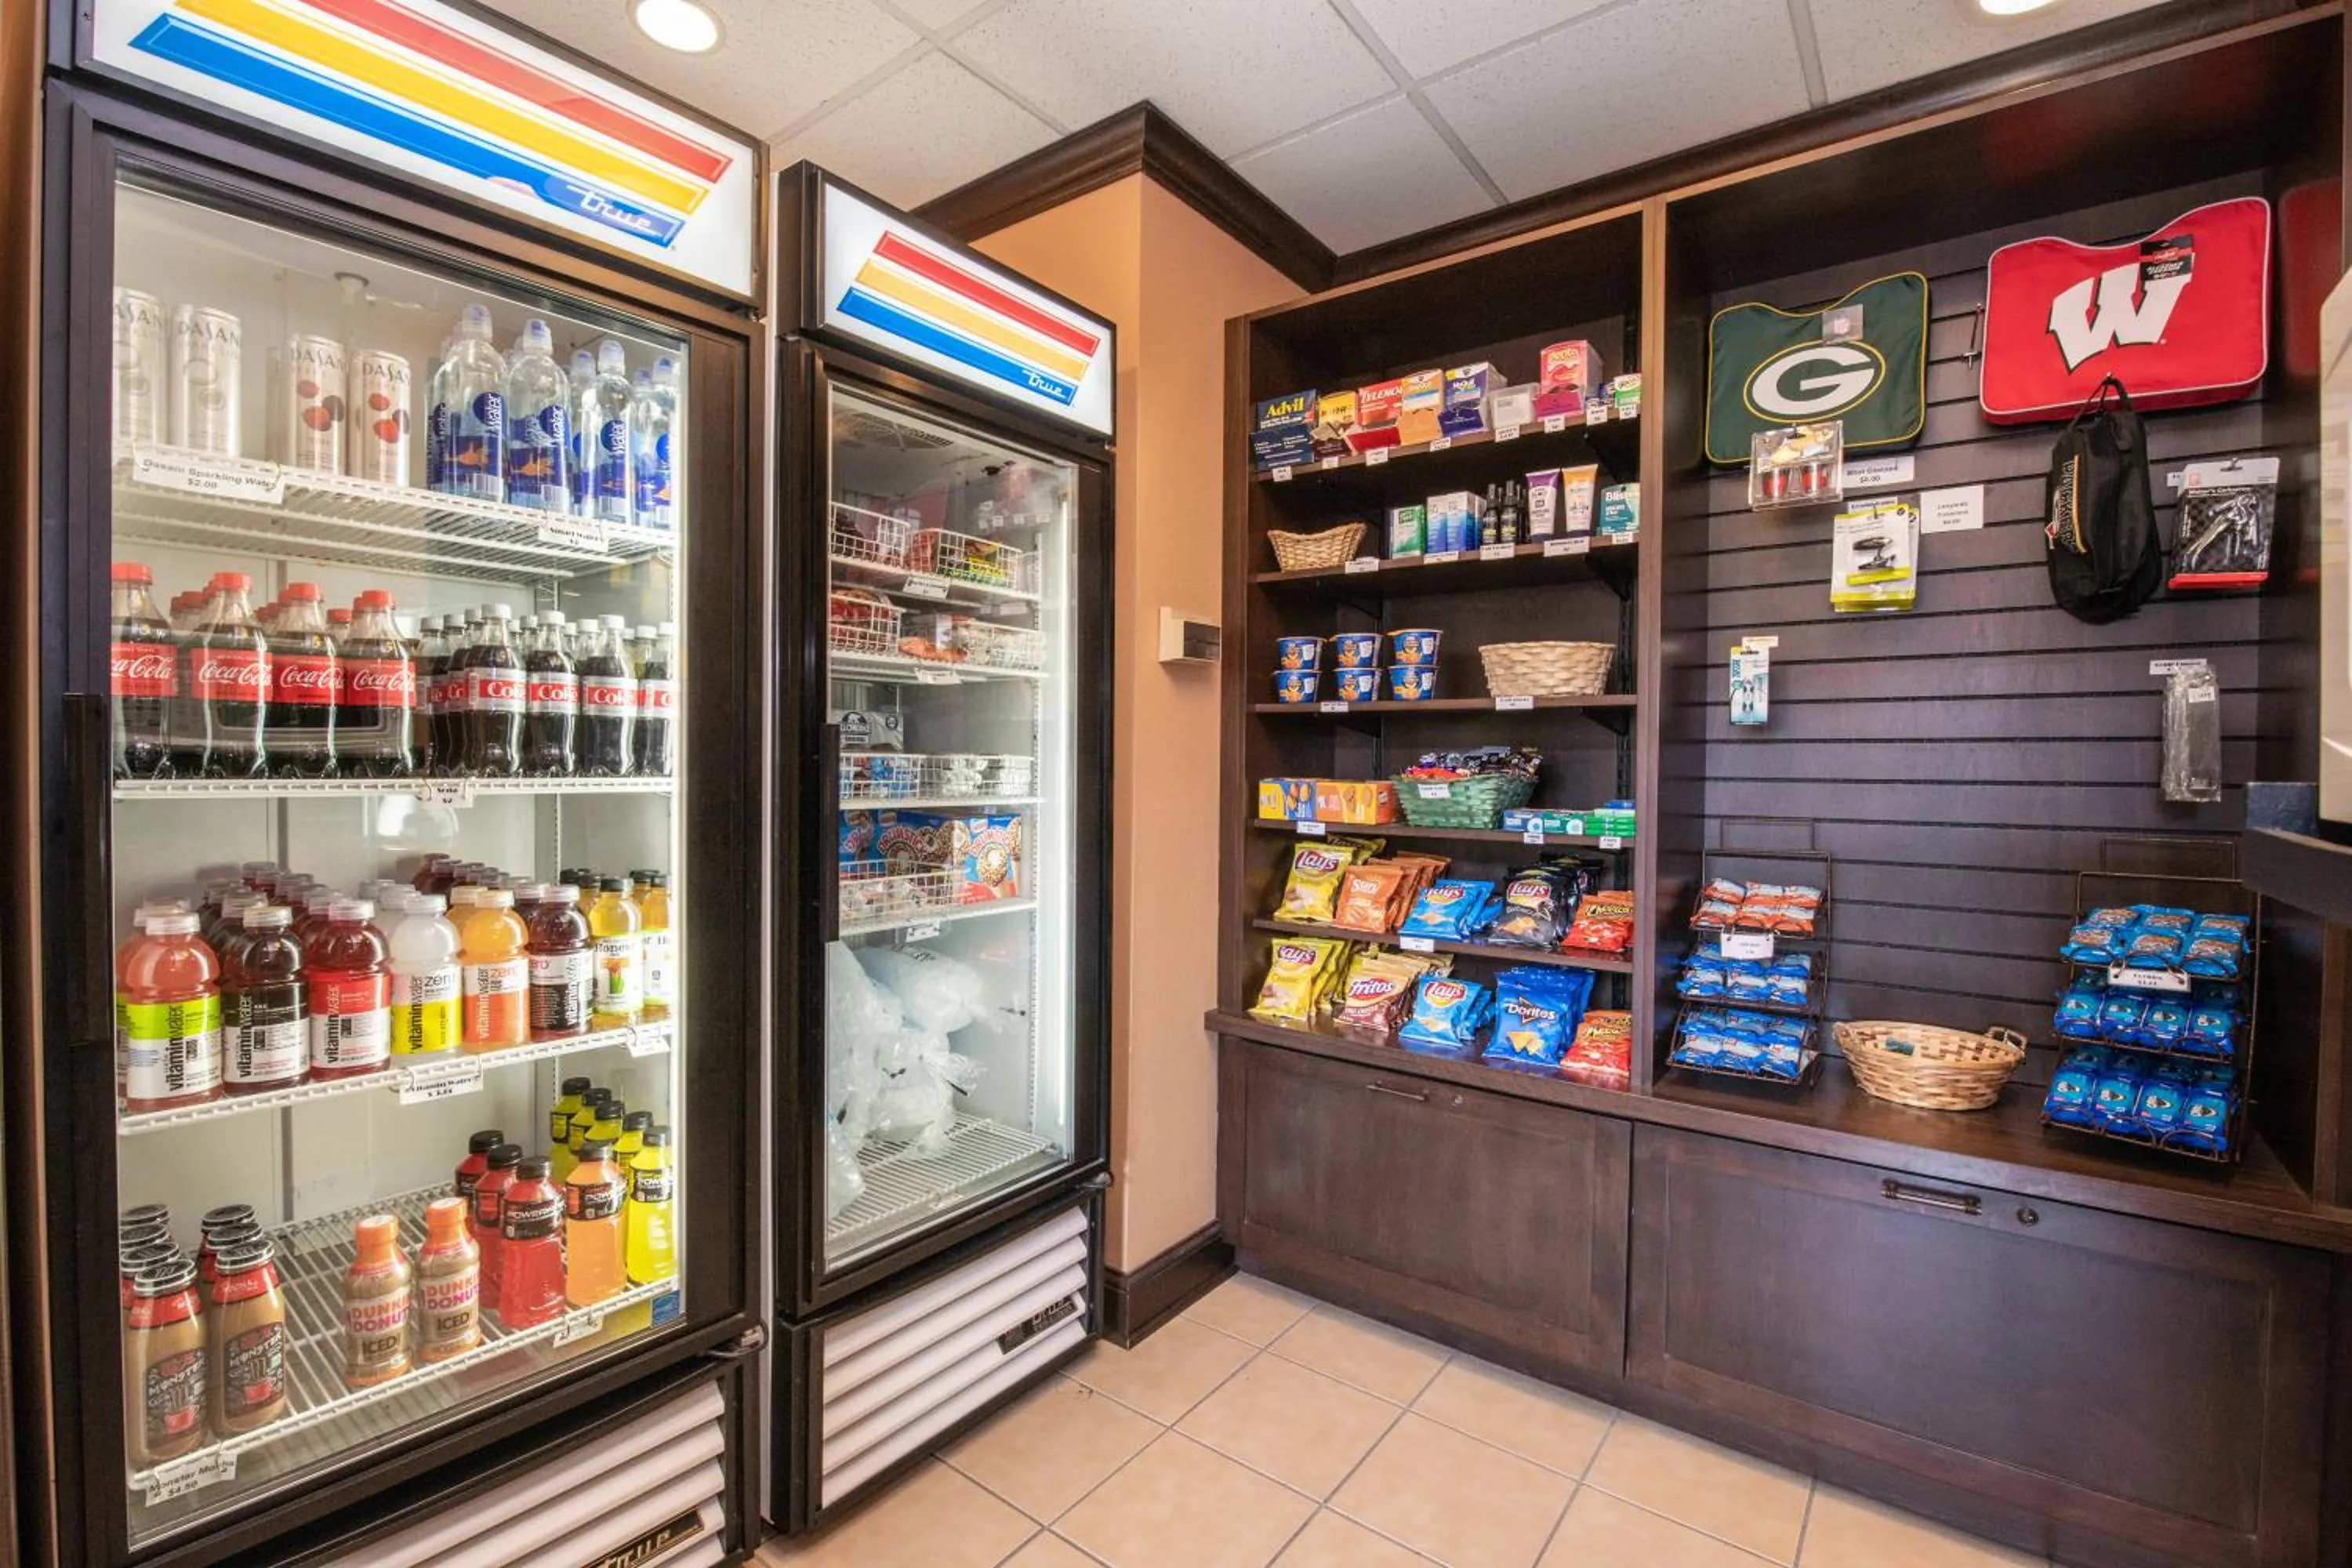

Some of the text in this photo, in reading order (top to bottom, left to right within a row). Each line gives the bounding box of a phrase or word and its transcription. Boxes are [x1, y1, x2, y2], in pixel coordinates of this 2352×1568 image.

[2047, 263, 2192, 375] W
[178, 321, 240, 347] DASAN
[291, 349, 347, 372] DASAN
[1751, 347, 1875, 415] G
[1266, 397, 1305, 418] Advil
[1508, 1003, 1556, 1020] Doritos
[354, 1305, 411, 1331] DONUT
[437, 1312, 470, 1330] ICED
[362, 1335, 397, 1356] ICED
